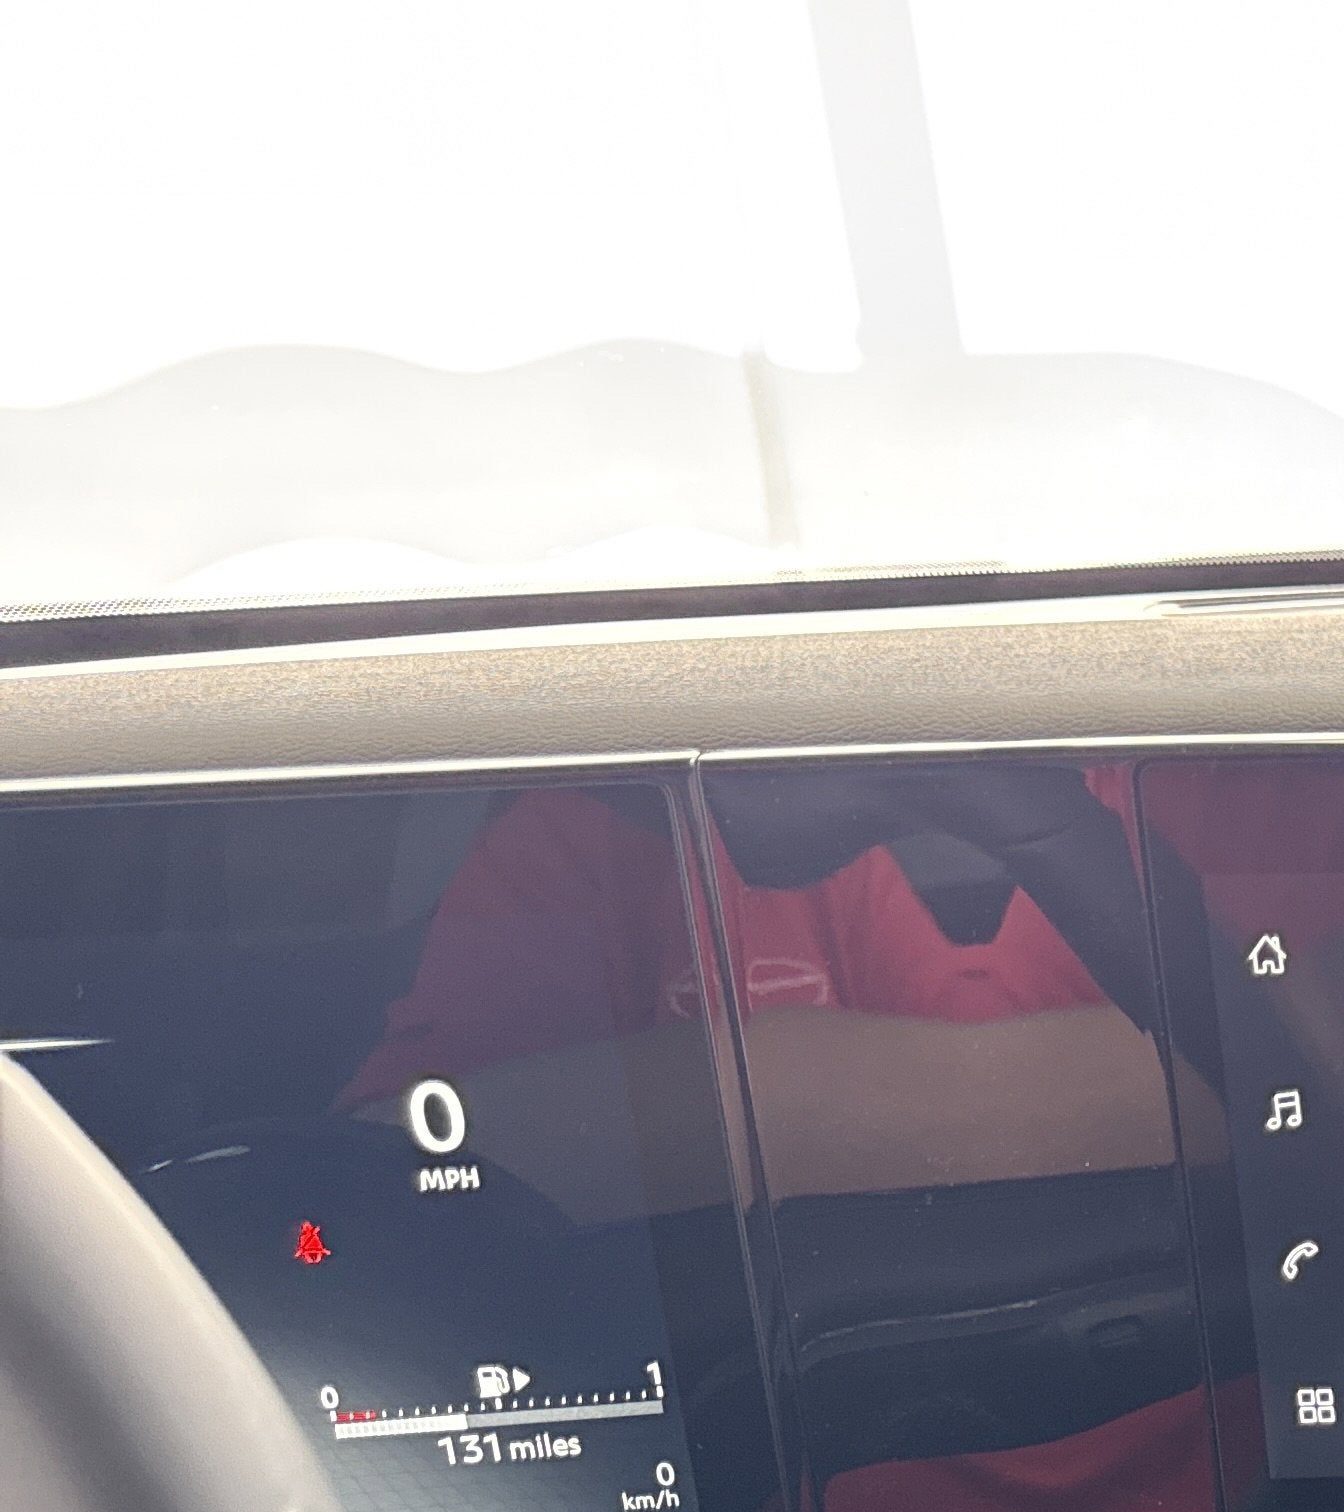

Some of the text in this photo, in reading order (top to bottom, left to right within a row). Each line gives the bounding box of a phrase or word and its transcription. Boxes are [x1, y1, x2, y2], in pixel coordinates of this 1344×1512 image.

[409, 1079, 466, 1154] 0
[419, 1166, 480, 1192] MPH
[647, 1361, 663, 1385] 1
[320, 1385, 340, 1409] 0
[437, 1434, 582, 1466] 131 miles
[655, 1462, 676, 1486] 0
[621, 1490, 680, 1512] km/h
